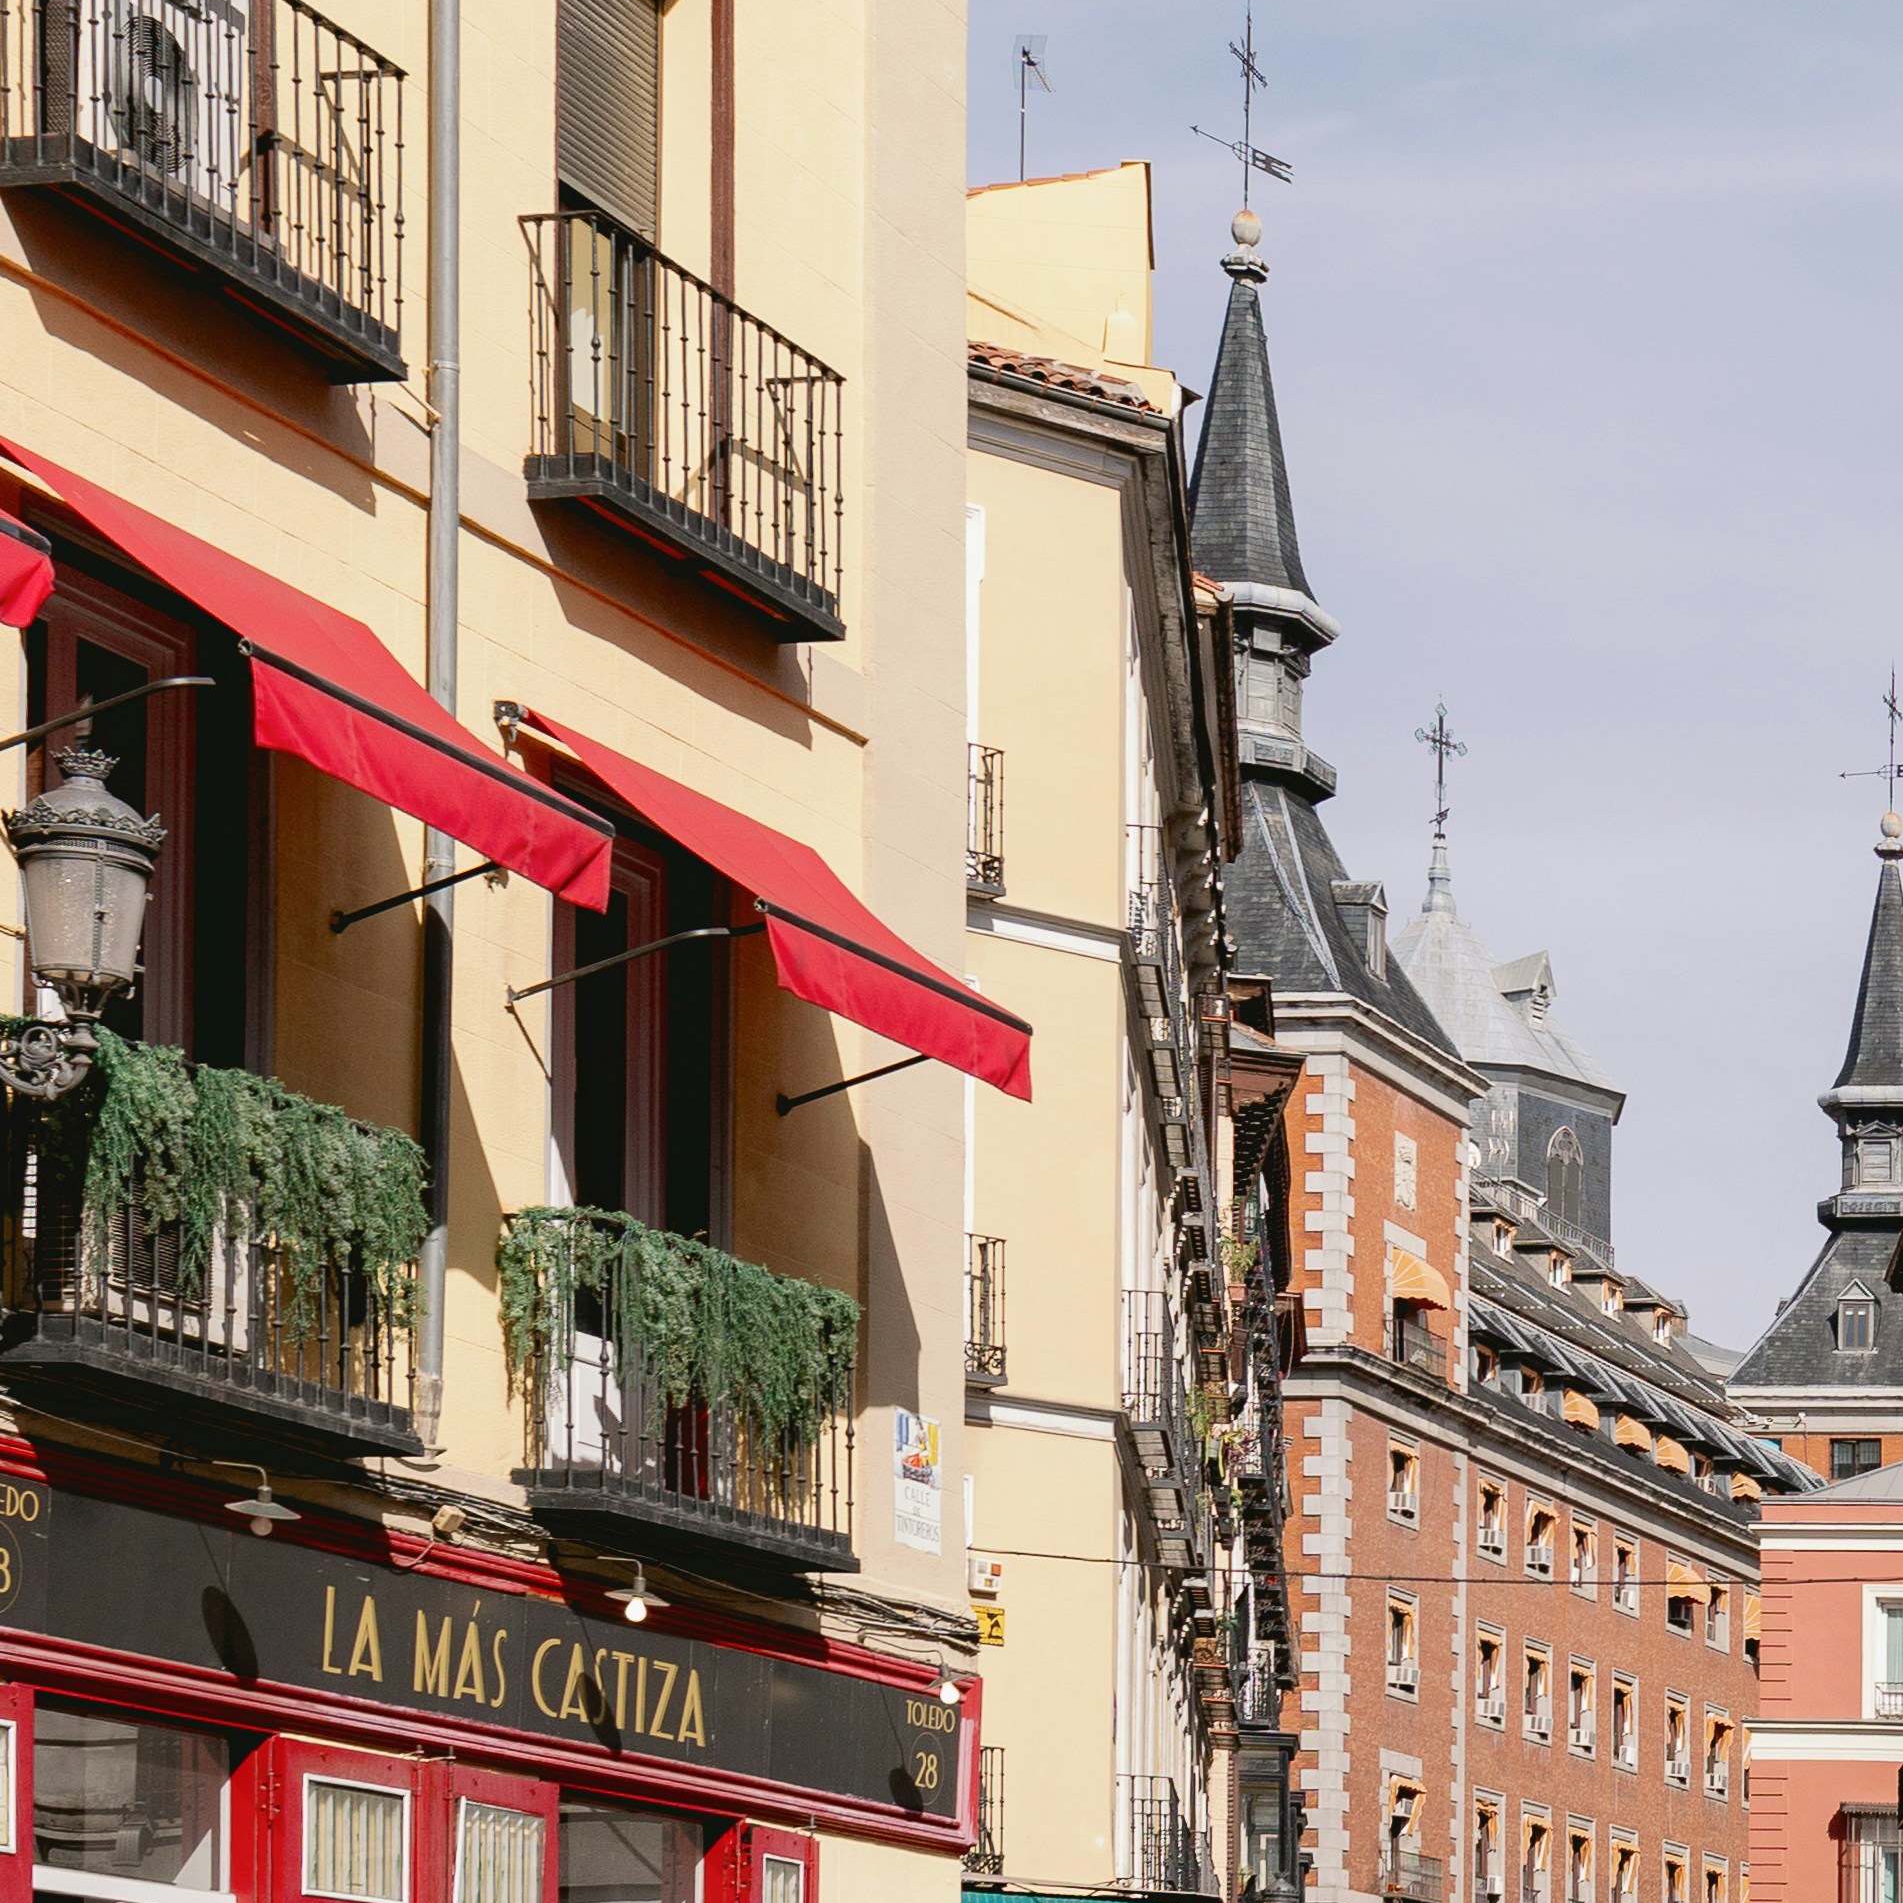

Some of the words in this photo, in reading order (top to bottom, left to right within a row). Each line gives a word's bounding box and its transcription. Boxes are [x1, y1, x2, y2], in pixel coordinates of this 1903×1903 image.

[904, 1486, 930, 1507] CALLE
[322, 1585, 383, 1683] LA
[413, 1599, 507, 1709] MÁS
[532, 1638, 706, 1747] CASTIZA
[906, 1700, 956, 1733] TOLEDO
[914, 1752, 938, 1789] 28
